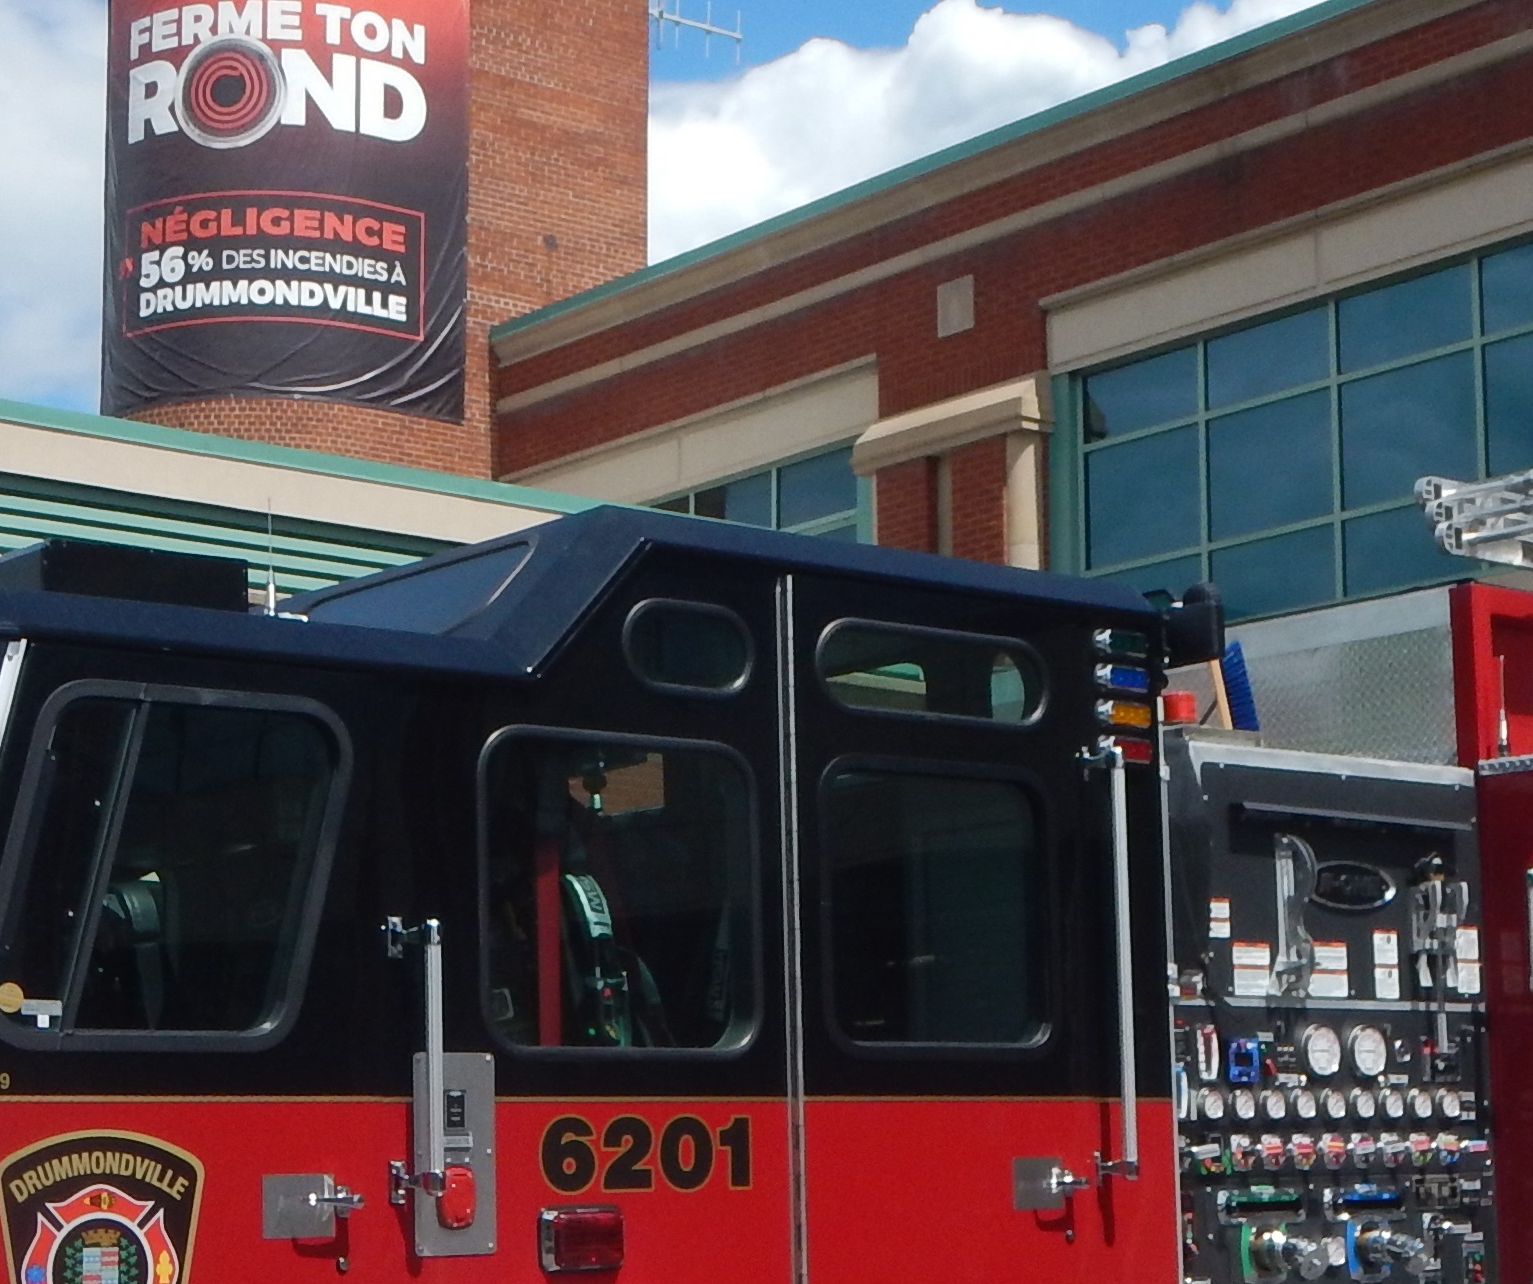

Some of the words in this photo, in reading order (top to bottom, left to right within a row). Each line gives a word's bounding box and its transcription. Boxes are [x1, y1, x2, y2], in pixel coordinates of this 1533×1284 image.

[130, 0, 303, 60] FERME
[315, 2, 426, 65] TON
[128, 48, 427, 149] ROND
[140, 206, 406, 253] NÉGLIGENCE
[139, 246, 214, 288] 56%
[222, 249, 266, 269] DES
[270, 249, 389, 282] INCENDIES
[390, 261, 407, 286] À
[139, 279, 407, 322] DRUMMONDVILLE
[9, 1151, 189, 1203] DRUMMONDVILLE
[539, 1113, 753, 1195] 6201
